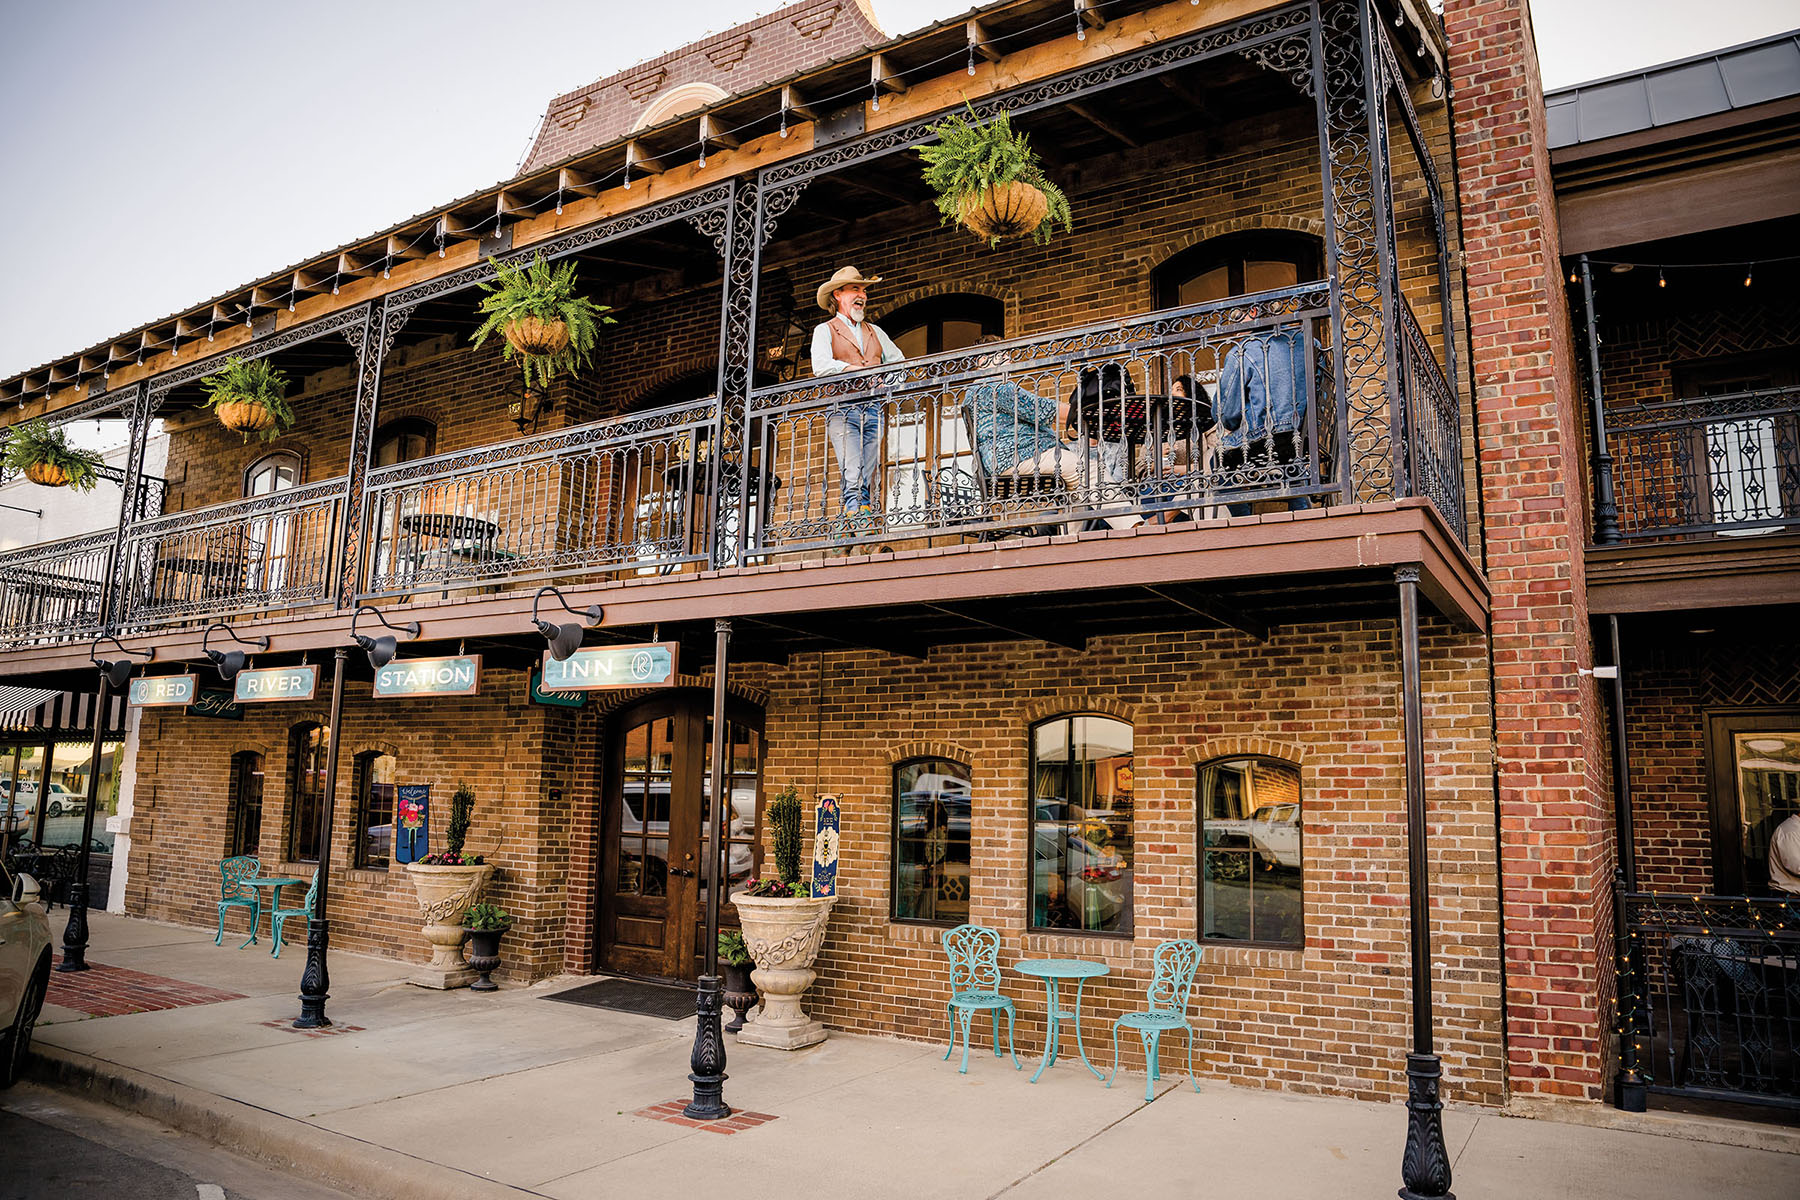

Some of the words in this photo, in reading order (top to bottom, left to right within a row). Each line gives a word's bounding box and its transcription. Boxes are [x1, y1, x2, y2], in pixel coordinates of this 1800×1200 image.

[380, 666, 470, 687] STATION
[562, 659, 613, 679] INN
[156, 684, 186, 697] RED
[247, 675, 302, 693] RIVER
[195, 694, 236, 715] Gifts
